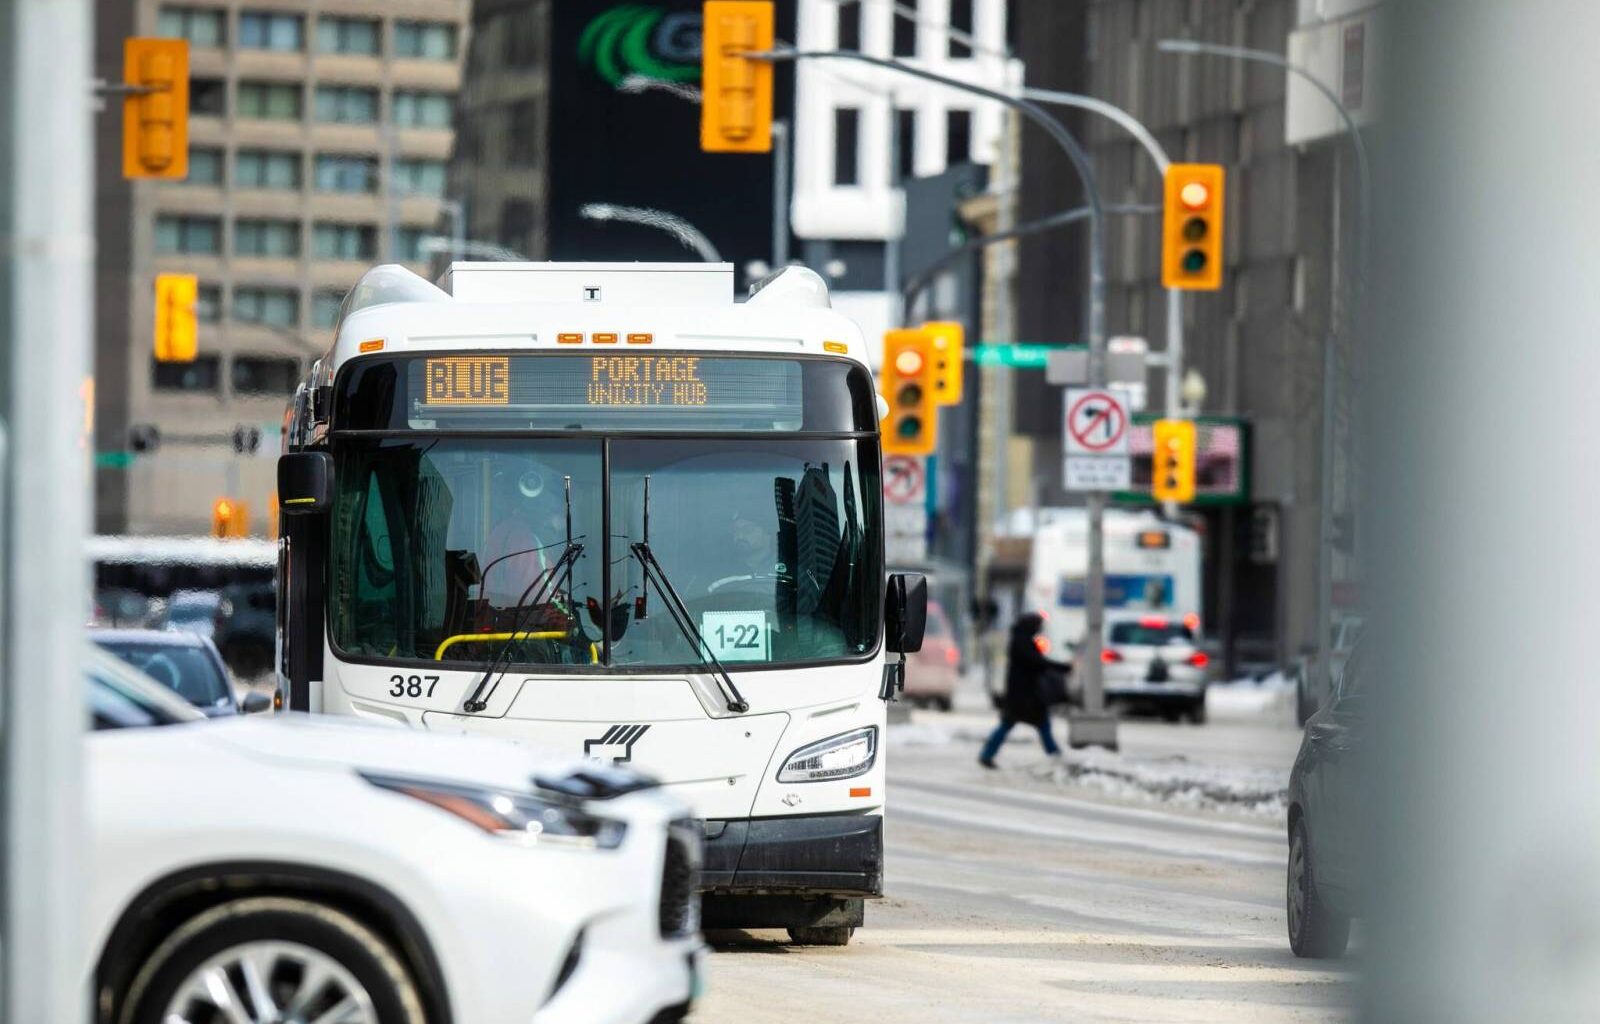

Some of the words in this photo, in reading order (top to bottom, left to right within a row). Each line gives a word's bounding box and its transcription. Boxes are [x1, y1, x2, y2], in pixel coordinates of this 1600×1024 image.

[585, 287, 600, 299] T
[429, 359, 505, 401] BLUE
[592, 357, 700, 381] PORTAGE
[588, 383, 664, 404] UNICITY
[673, 383, 707, 404] HUB
[715, 624, 760, 649] 1-22
[389, 674, 440, 698] 387
